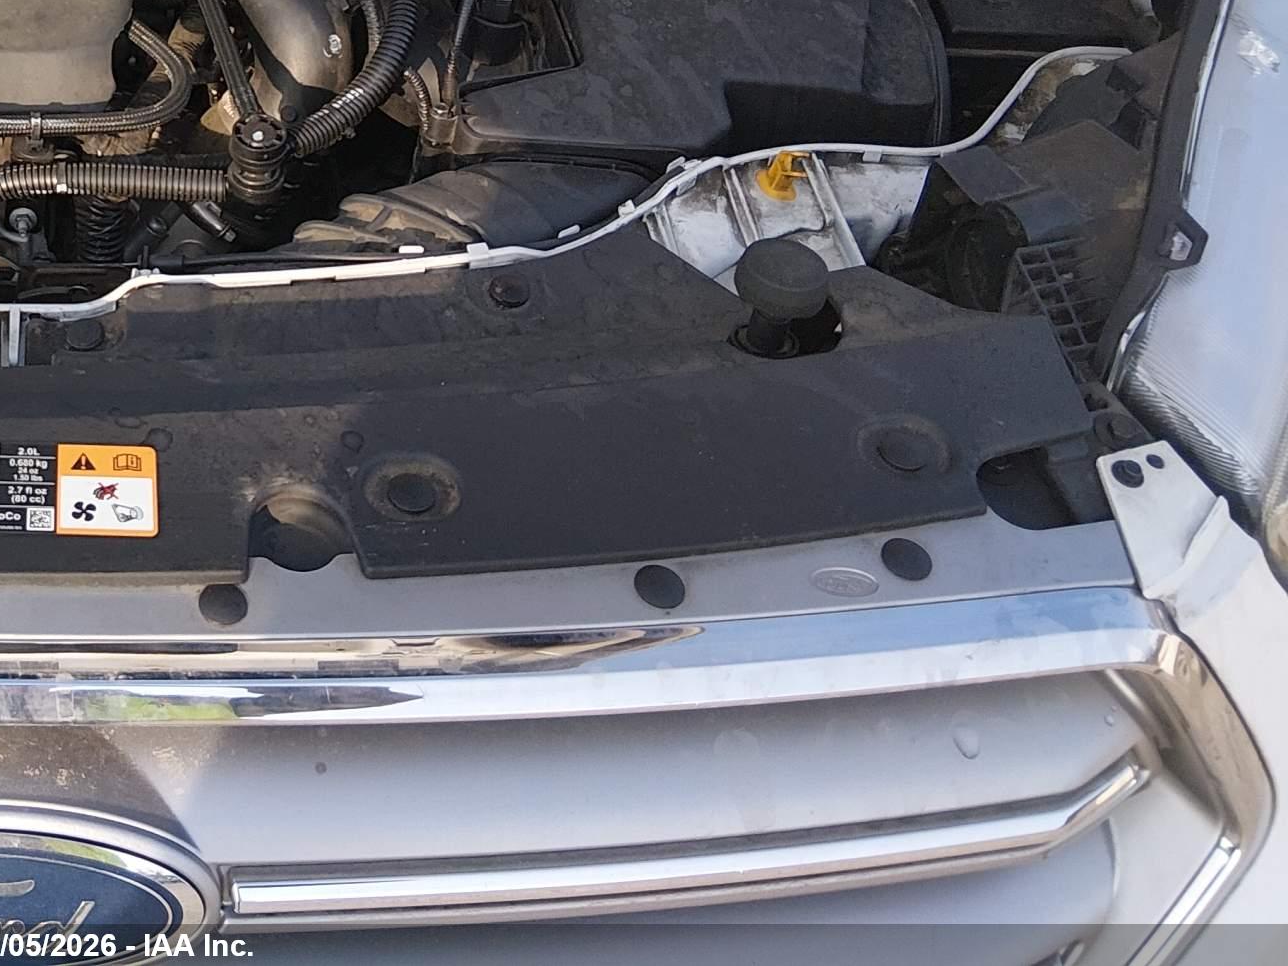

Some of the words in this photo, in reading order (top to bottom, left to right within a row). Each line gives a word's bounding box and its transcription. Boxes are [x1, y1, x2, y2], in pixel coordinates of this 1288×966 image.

[17, 447, 40, 456] 2.0L
[9, 458, 34, 467] 0.680
[35, 459, 48, 470] kg
[13, 473, 29, 481] 1.50
[30, 474, 43, 482] lbs
[8, 486, 23, 494] 2.7
[25, 486, 33, 494] fl
[34, 487, 48, 495] oz
[11, 495, 27, 504] (80
[29, 495, 45, 504] cc)
